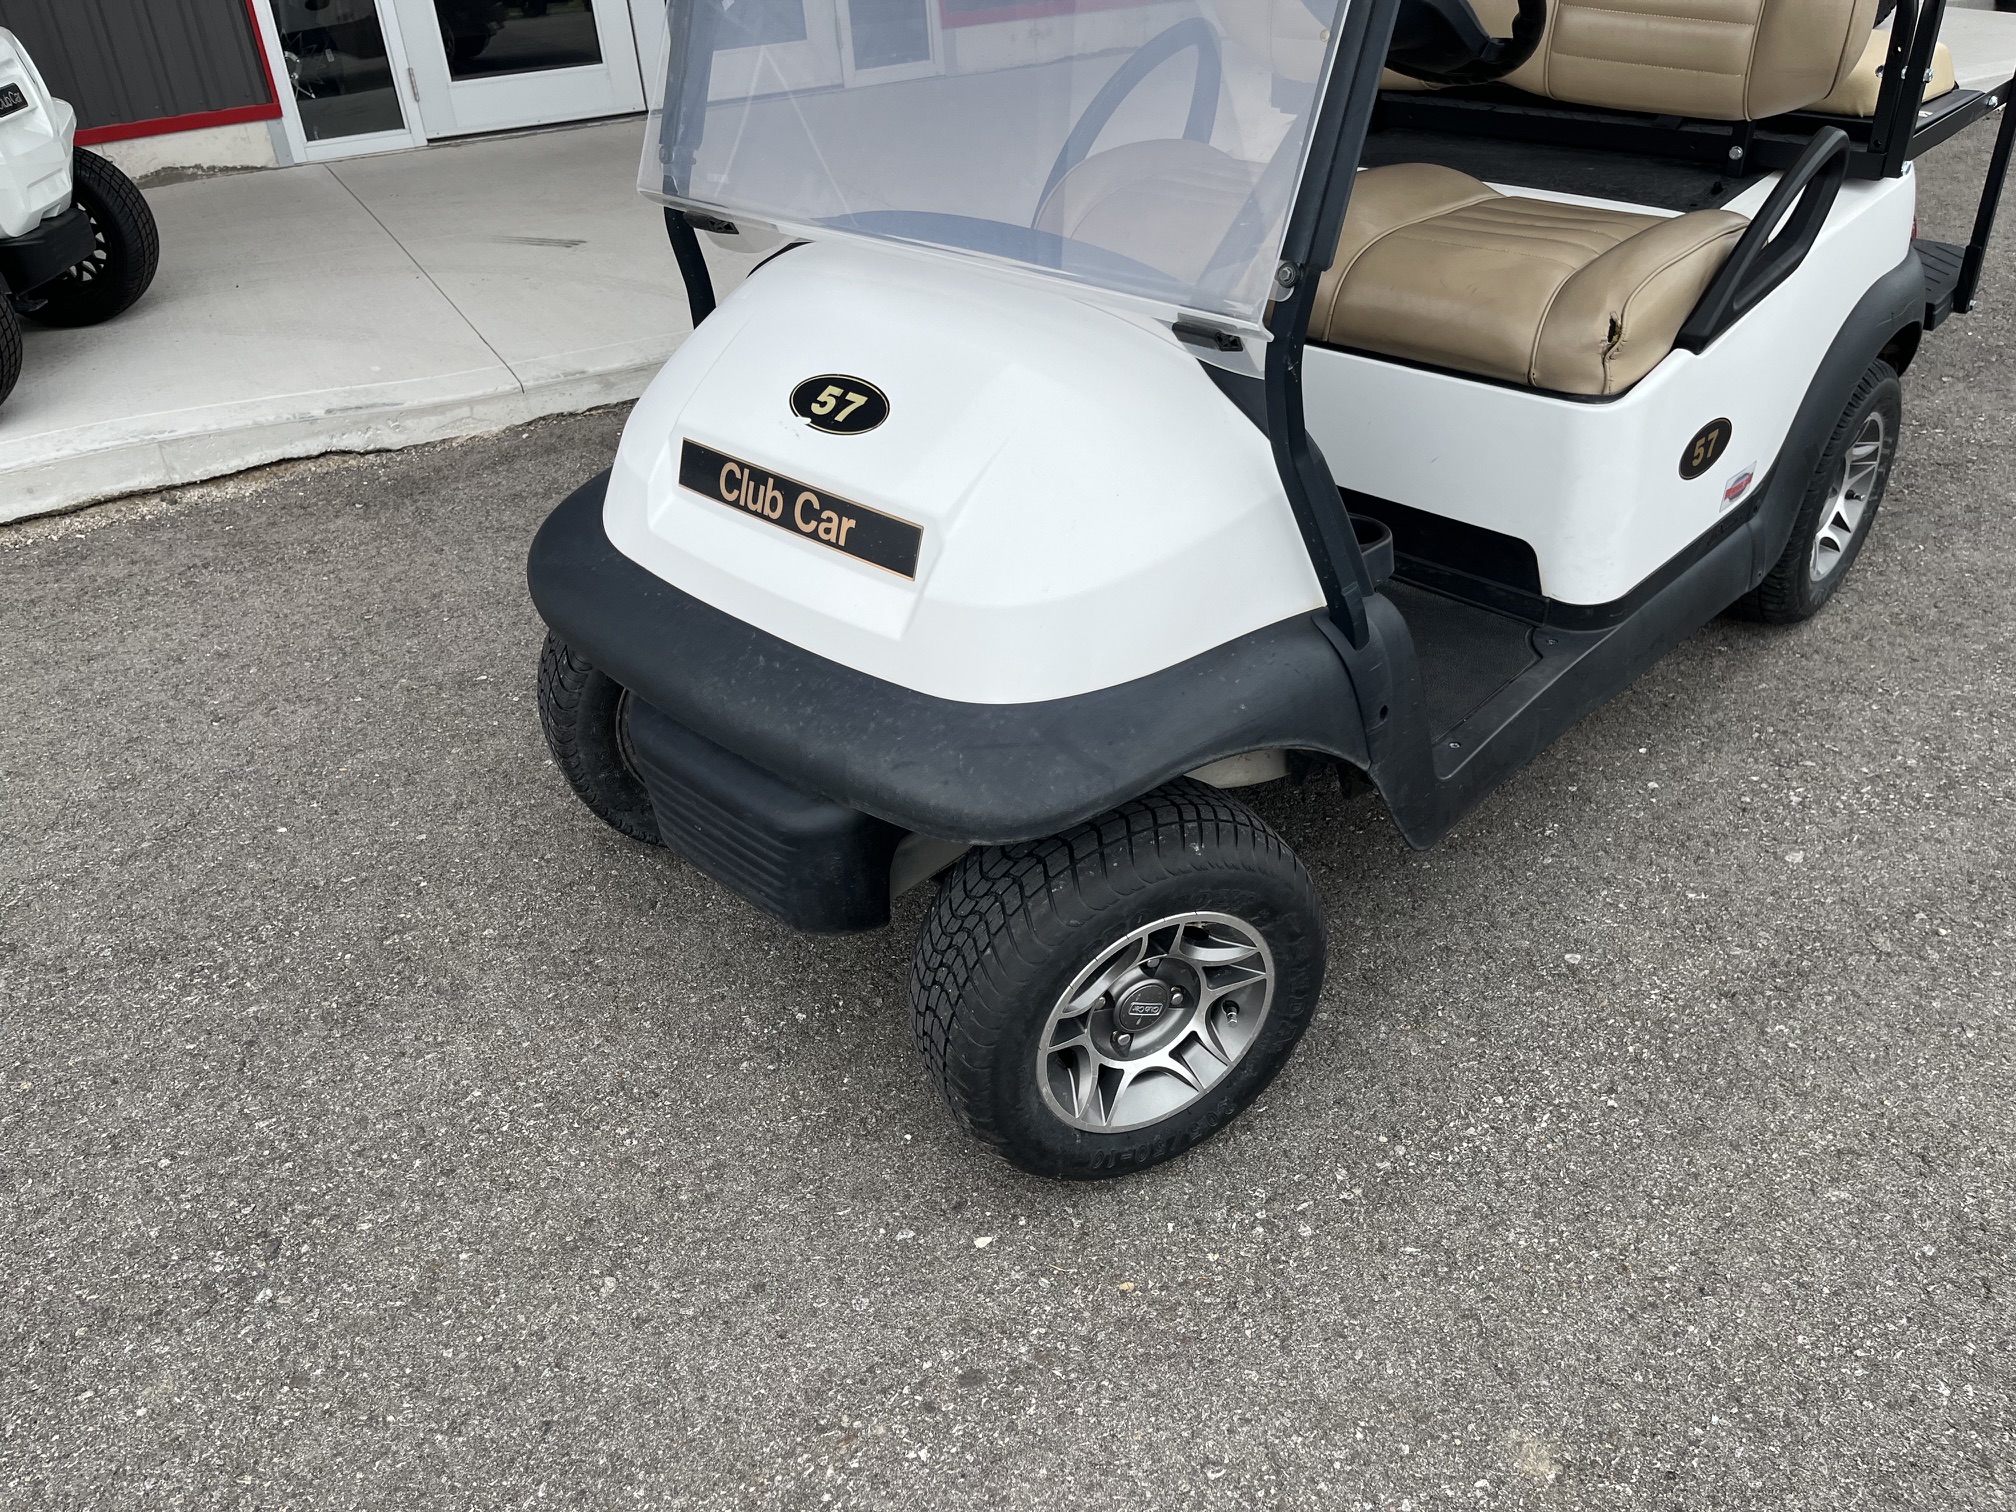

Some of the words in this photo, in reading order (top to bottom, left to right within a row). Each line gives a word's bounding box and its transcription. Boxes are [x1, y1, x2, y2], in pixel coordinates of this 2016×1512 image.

[811, 385, 868, 422] 57
[1692, 429, 1719, 467] 57
[719, 461, 784, 520] Club
[794, 491, 856, 547] Car
[1091, 1096, 1237, 1170] 205/50-10
